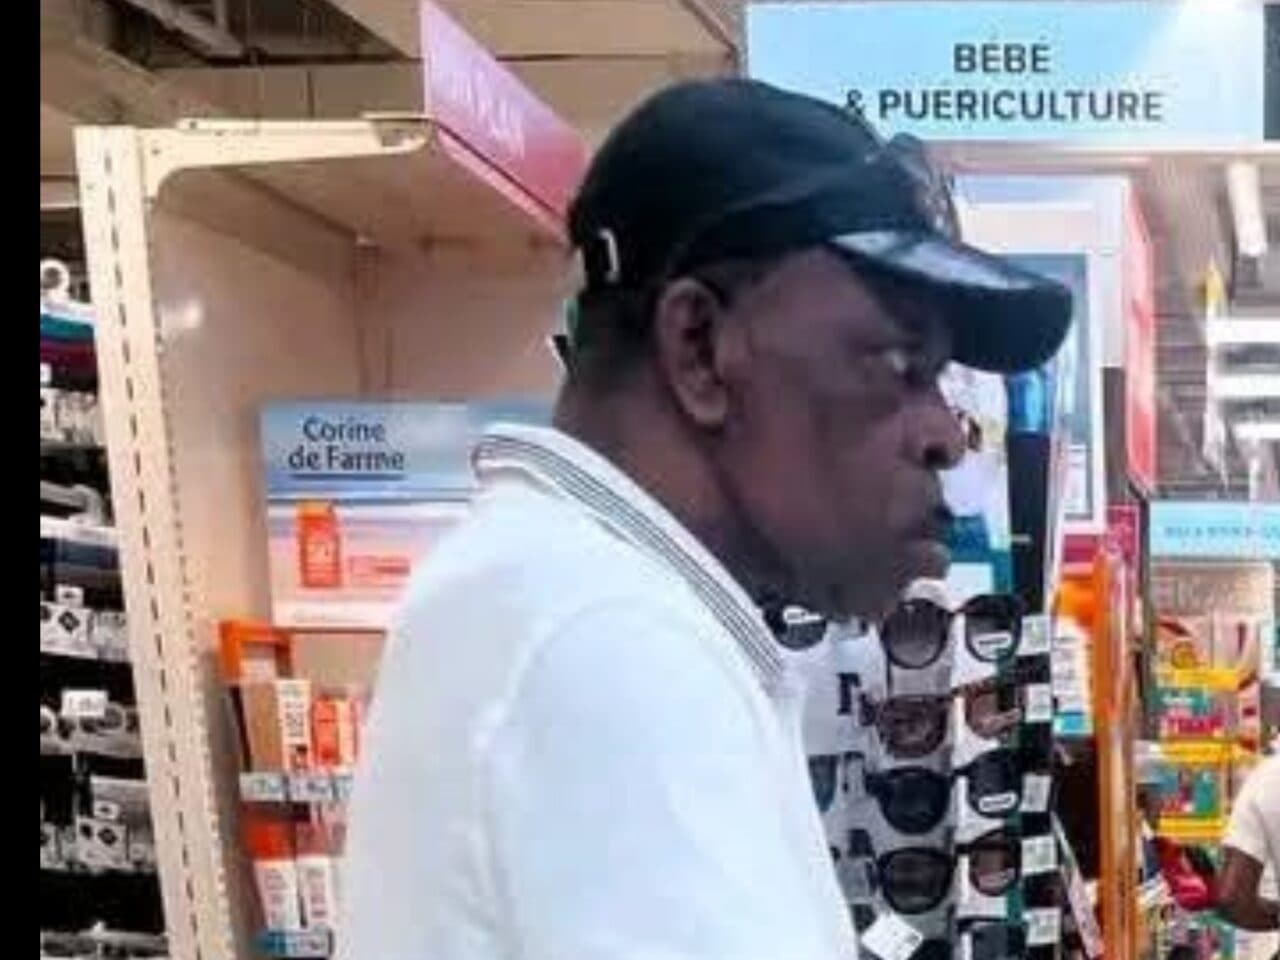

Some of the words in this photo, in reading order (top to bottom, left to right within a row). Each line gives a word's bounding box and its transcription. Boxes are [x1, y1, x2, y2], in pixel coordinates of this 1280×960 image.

[303, 416, 385, 441] Corine
[288, 445, 320, 470] de
[326, 445, 404, 470] Farme
